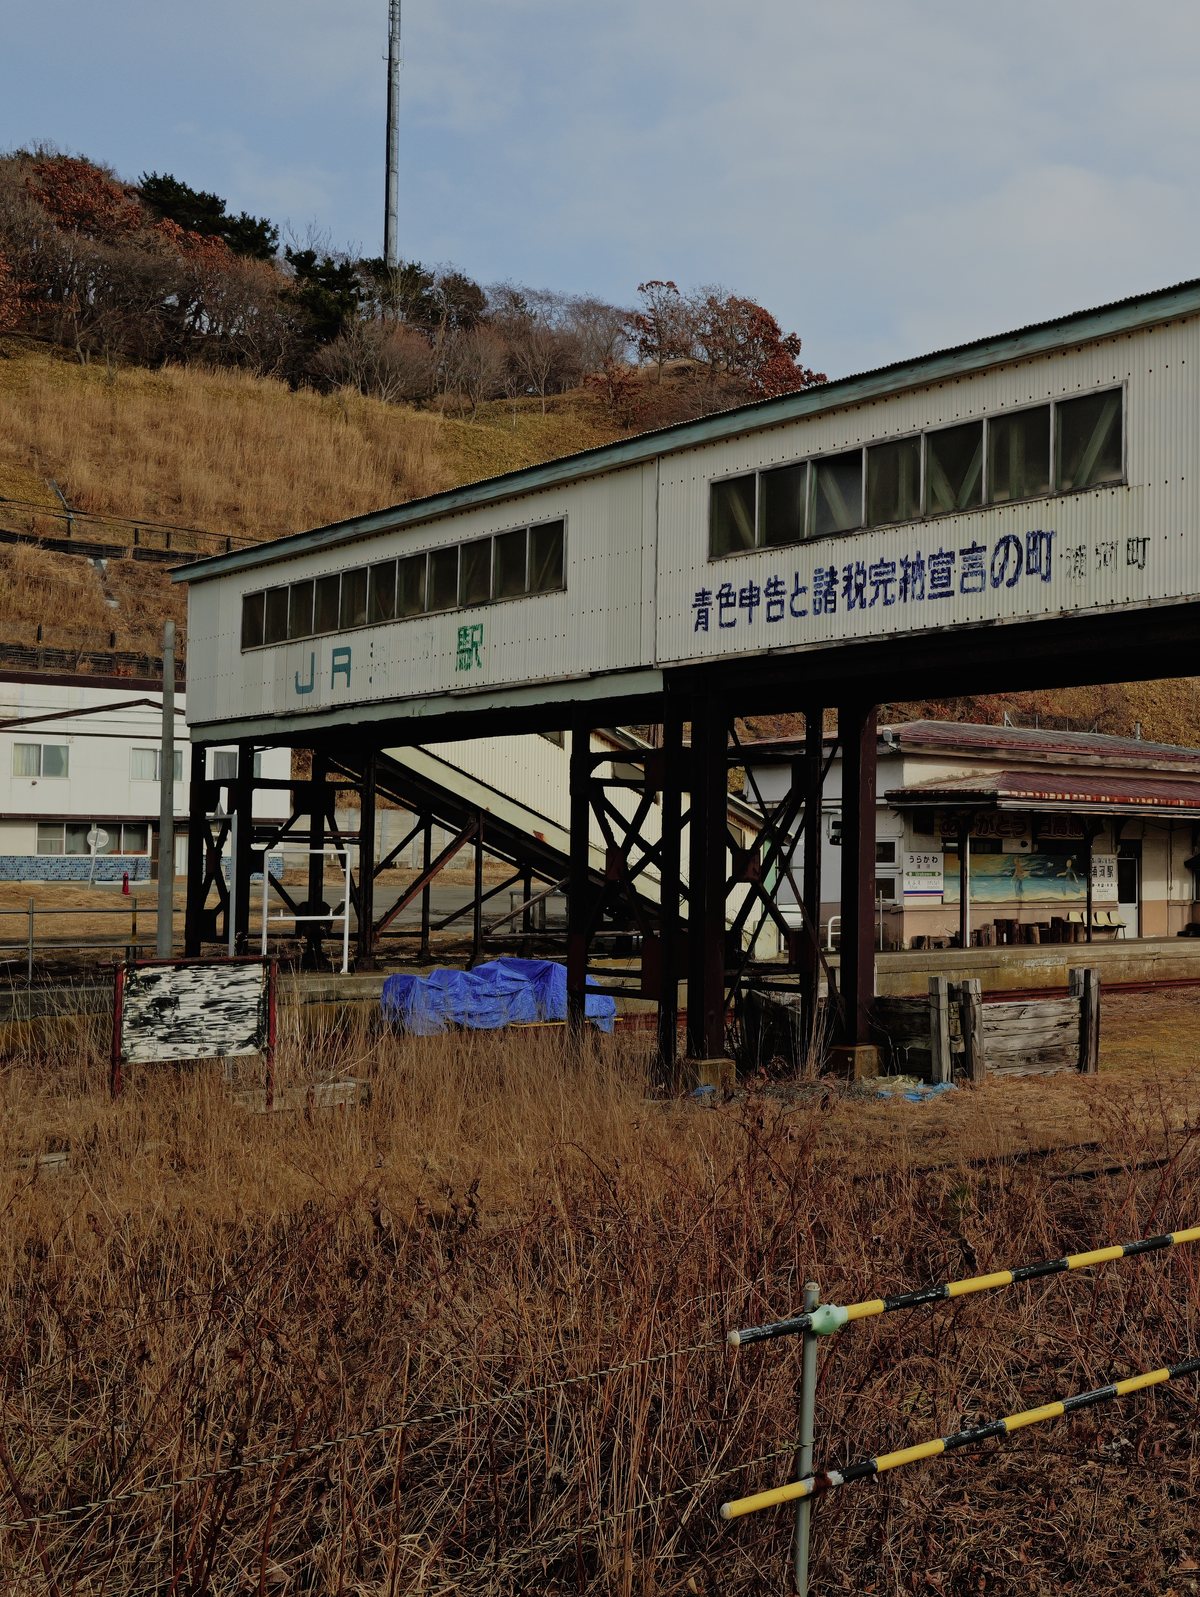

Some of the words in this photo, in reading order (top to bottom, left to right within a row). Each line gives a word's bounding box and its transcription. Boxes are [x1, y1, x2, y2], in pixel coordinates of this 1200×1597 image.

[692, 530, 1056, 632] 青色申告と諸税完納宣言の町
[455, 623, 483, 671] 駅
[909, 855, 939, 864] うらかわ
